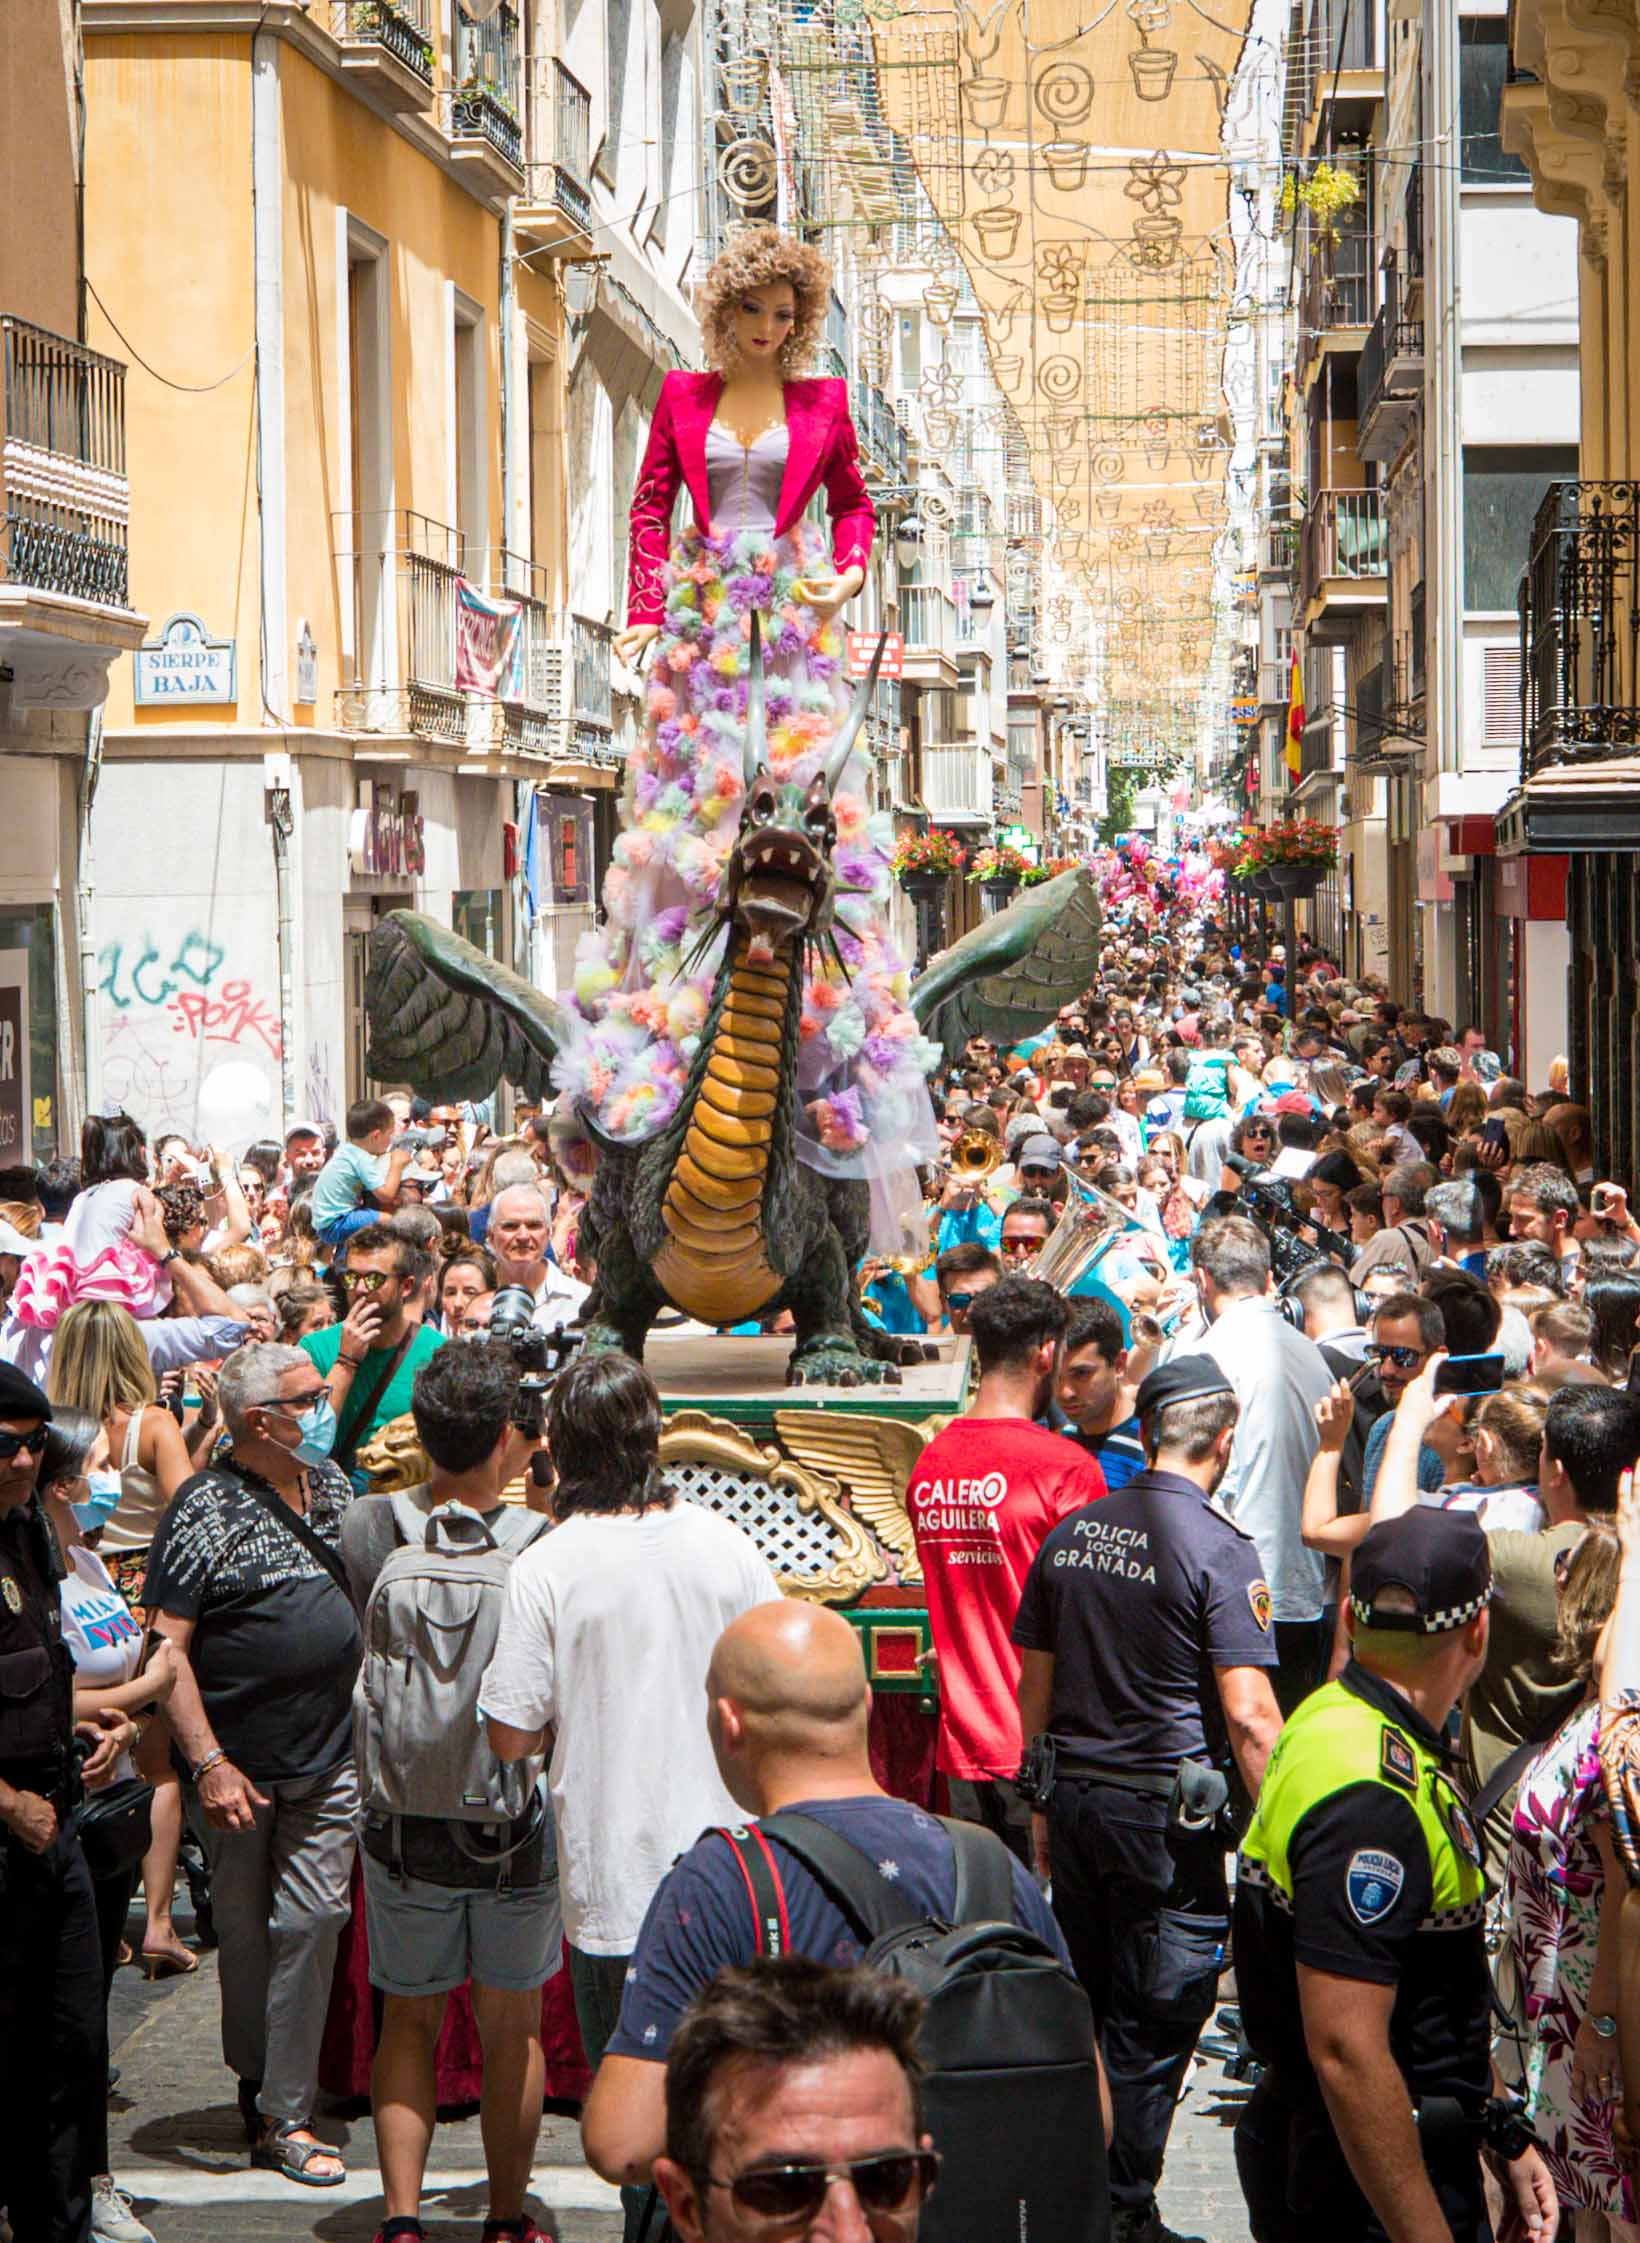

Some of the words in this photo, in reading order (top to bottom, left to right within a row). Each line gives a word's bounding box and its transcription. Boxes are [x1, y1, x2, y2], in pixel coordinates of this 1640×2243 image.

[149, 653, 220, 669] SIERPE
[152, 675, 217, 693] BAJA
[914, 1471, 1008, 1507] CALERO
[917, 1509, 1001, 1533] AGUILERA
[1073, 1519, 1149, 1550] POLICIA
[1086, 1539, 1127, 1558] LOCAL
[1053, 1549, 1157, 1585] GRANADA
